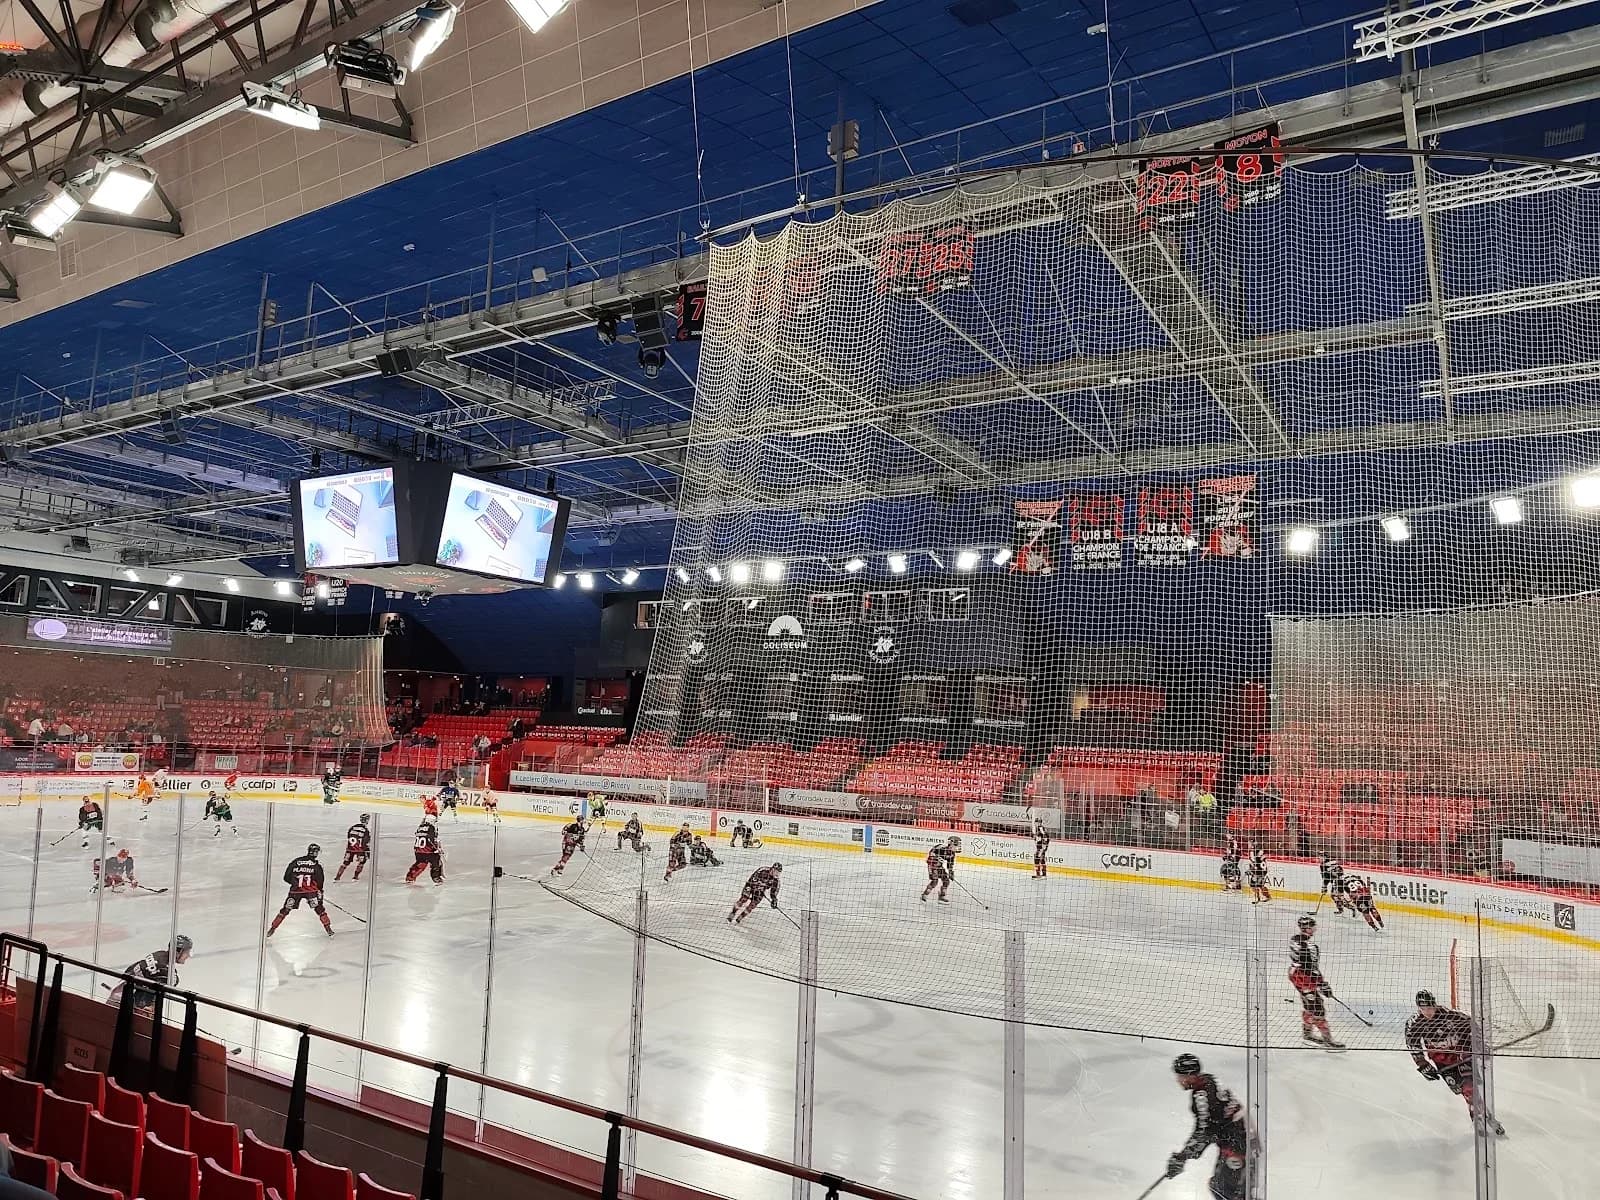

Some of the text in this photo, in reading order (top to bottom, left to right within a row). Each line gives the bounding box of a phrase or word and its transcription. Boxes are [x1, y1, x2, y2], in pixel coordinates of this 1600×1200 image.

[1237, 154, 1262, 183] 8
[1148, 171, 1188, 206] 22
[690, 297, 706, 321] 7
[1147, 522, 1178, 533] U18 A
[1081, 530, 1111, 541] U18 B
[1072, 543, 1119, 553] CHAMPION
[1073, 551, 1120, 561] DE FRANCE
[331, 579, 344, 587] U20
[763, 641, 808, 650] COLISEUM
[248, 779, 276, 790] cafpi
[991, 849, 1064, 864] Hauts-de-nce
[1110, 853, 1152, 872] cafpi
[296, 874, 312, 888] 11
[1366, 876, 1448, 905] hotellier
[1504, 906, 1515, 914] DE
[1518, 909, 1551, 922] FRANCE
